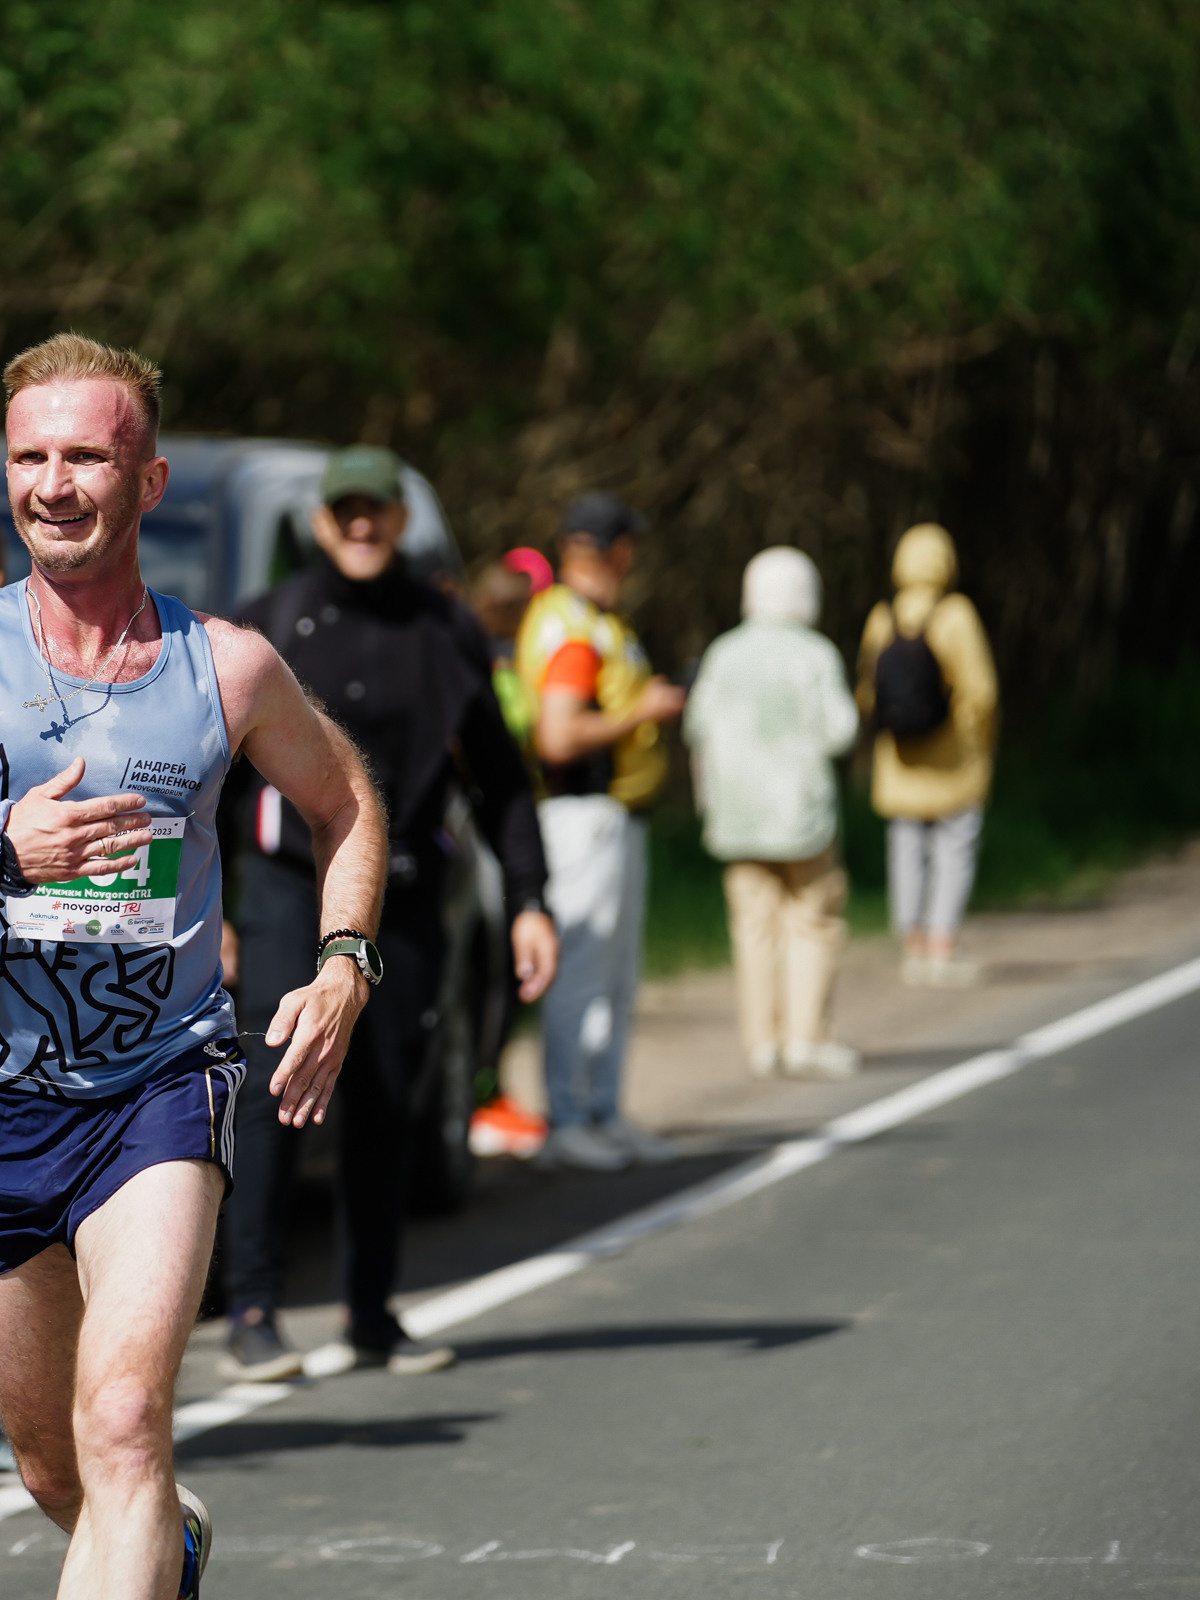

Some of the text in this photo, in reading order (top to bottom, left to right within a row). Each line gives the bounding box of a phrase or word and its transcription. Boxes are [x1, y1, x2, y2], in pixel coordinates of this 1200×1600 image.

[134, 759, 187, 776] АНДРЕЙ
[130, 771, 202, 792] ИВАНЕНКОВ
[127, 783, 184, 797] #NOVGORODRUN
[152, 828, 172, 836] 2023
[36, 885, 152, 901] Мужики NovgorodTRI
[203, 1045, 227, 1059] adidas
